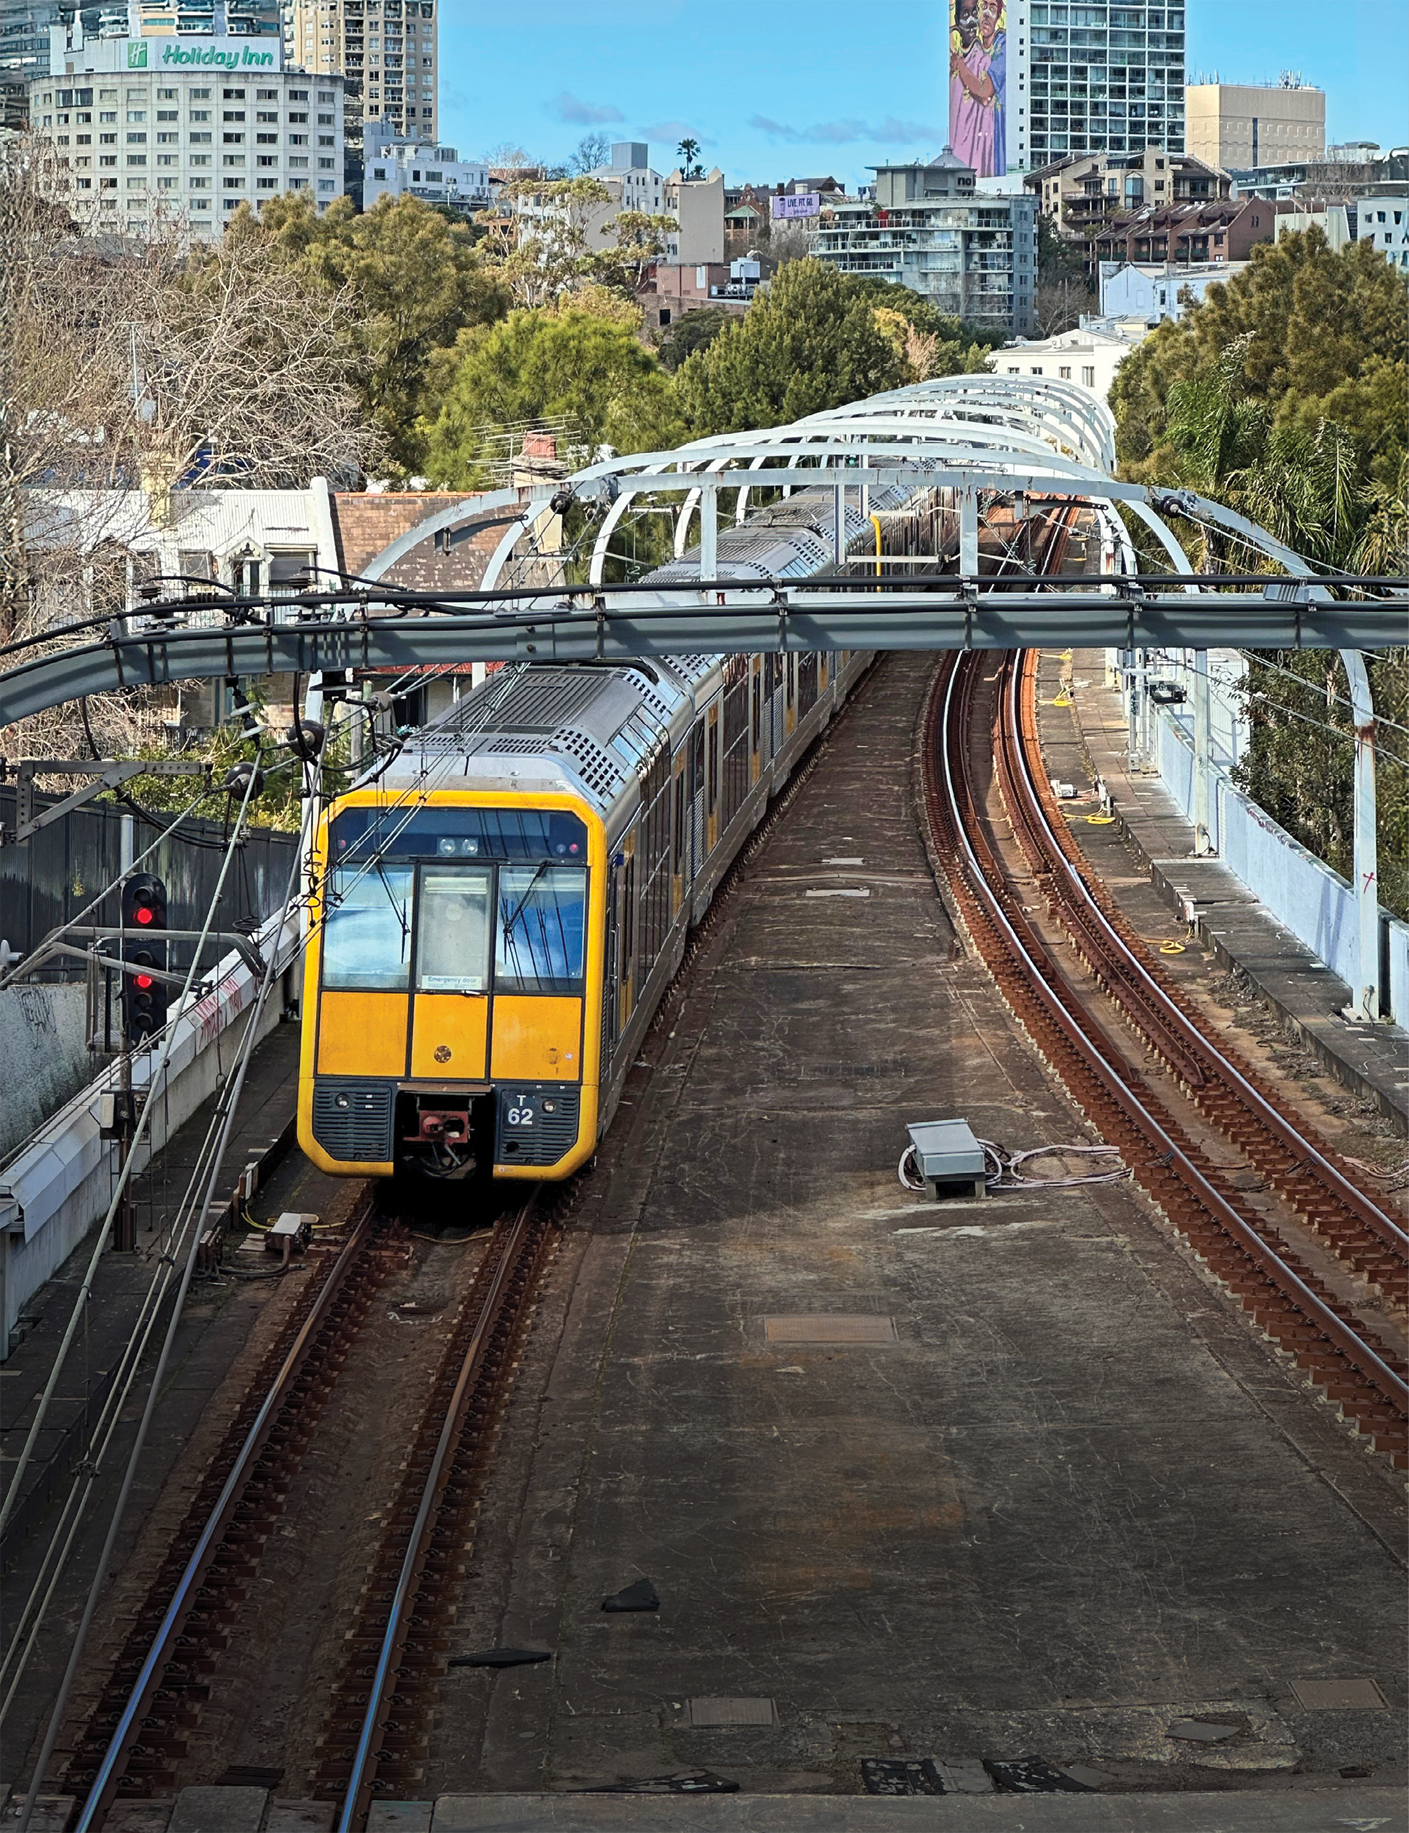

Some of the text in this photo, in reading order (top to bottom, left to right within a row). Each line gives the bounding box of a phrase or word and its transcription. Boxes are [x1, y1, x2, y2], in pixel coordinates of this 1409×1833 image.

[162, 44, 273, 69] Holiday Inn
[427, 976, 462, 984] Emergency
[516, 1094, 527, 1107] T
[507, 1107, 534, 1125] 62
